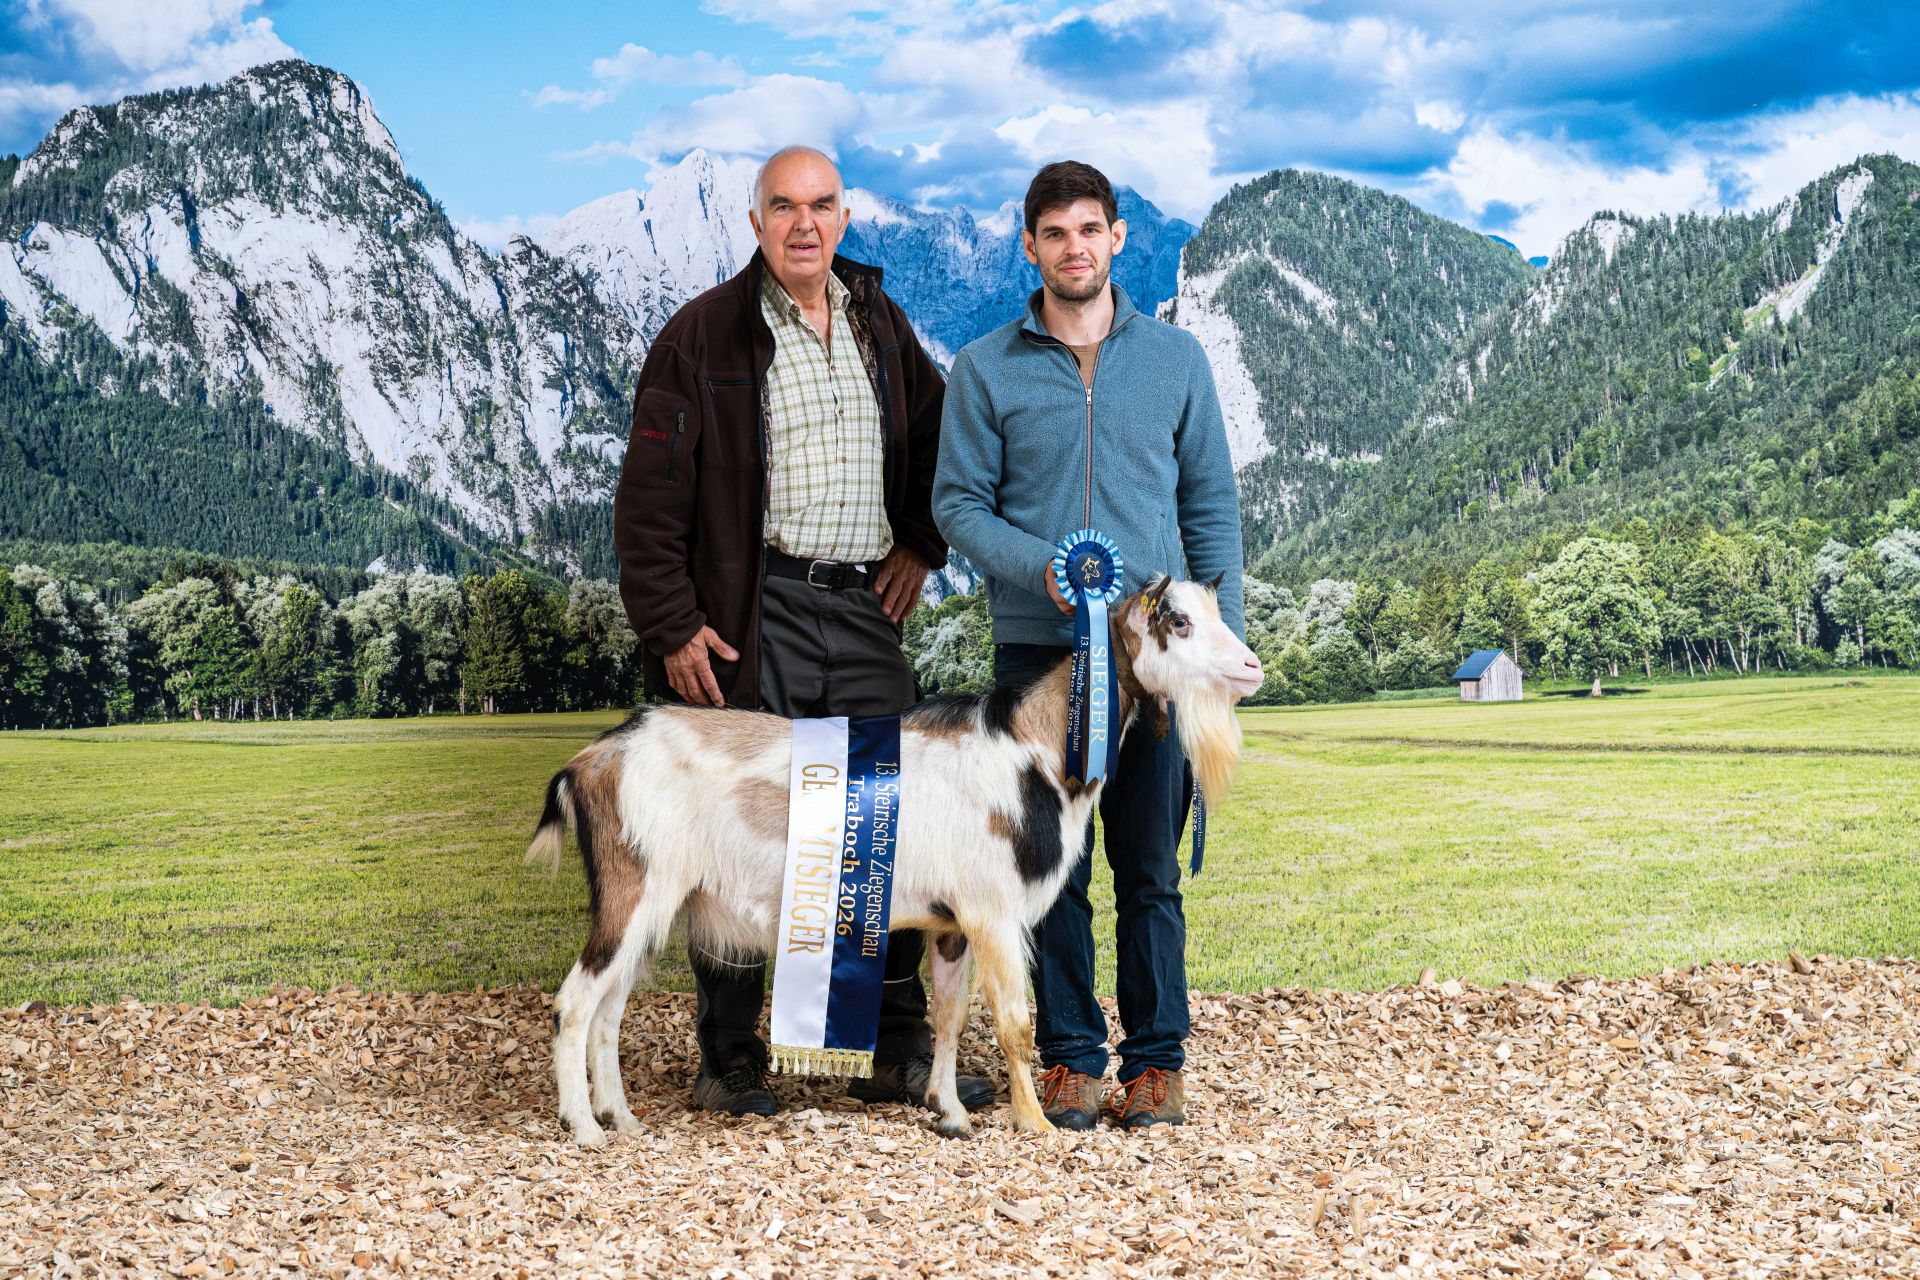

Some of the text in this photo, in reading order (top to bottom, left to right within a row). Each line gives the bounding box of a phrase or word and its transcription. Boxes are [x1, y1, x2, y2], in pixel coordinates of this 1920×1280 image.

[1072, 635, 1089, 752] 13. Steirische Ziegenschau
[1090, 644, 1108, 745] SIEGER
[788, 764, 840, 954] GEMTSIEGER
[837, 775, 866, 936] Traboch 2026
[860, 761, 898, 957] 13. Steirische Ziegenschau
